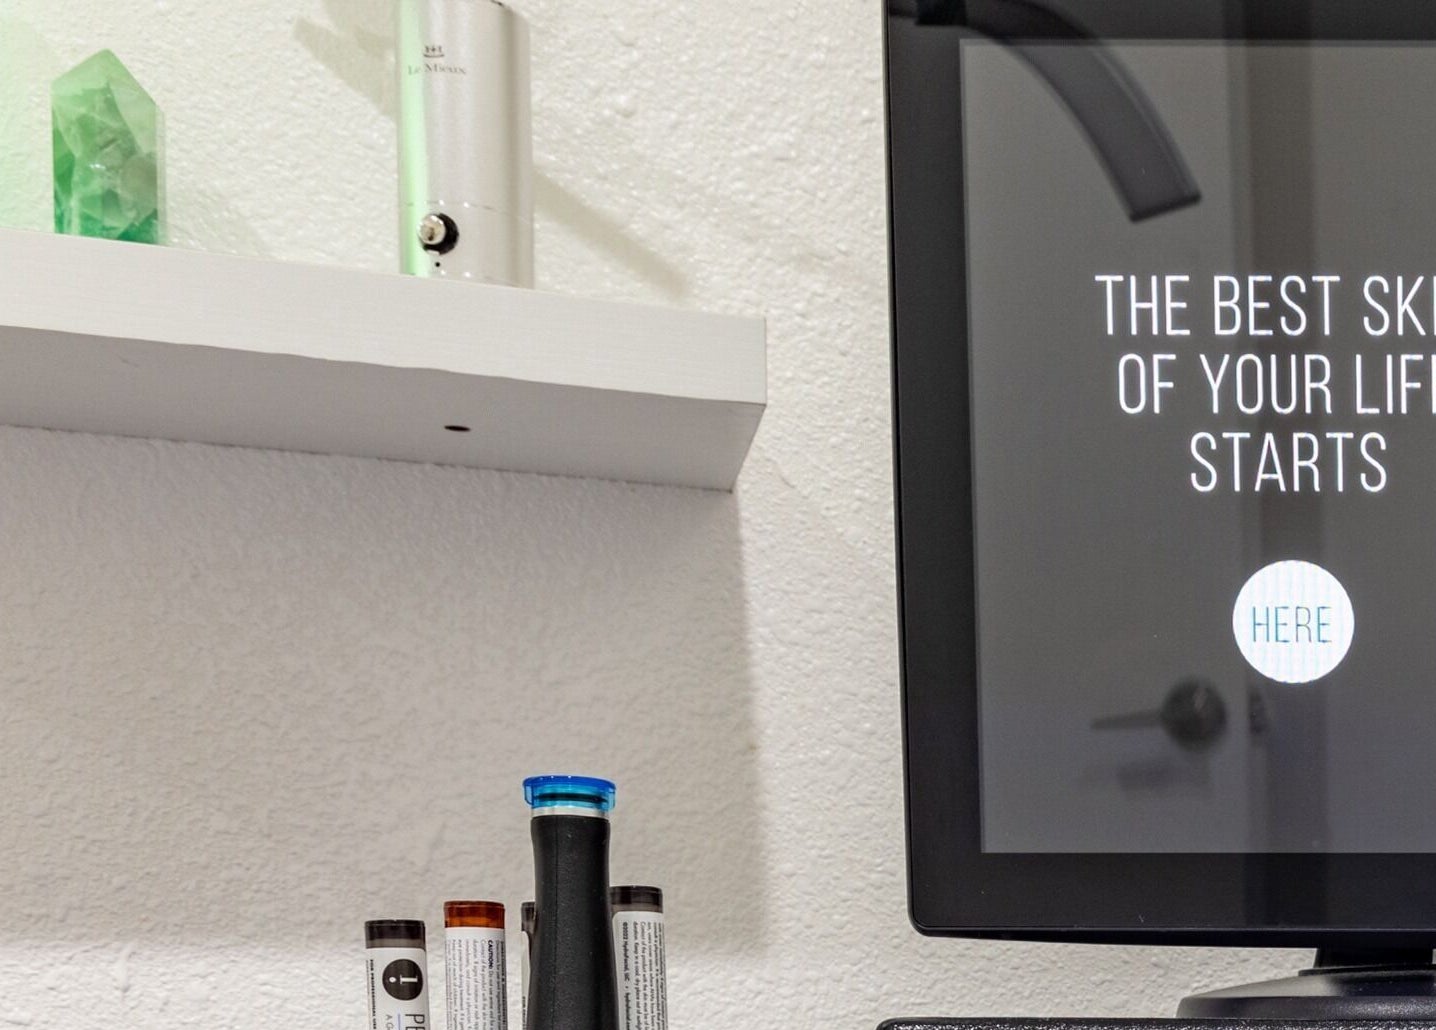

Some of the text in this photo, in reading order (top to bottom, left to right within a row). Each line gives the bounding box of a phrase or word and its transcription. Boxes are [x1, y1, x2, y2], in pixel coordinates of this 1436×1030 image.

[1094, 274, 1191, 336] THE
[1213, 275, 1341, 336] BEST
[1118, 353, 1177, 415] OF
[1199, 353, 1332, 415] YOUR
[1190, 431, 1387, 493] STARTS
[1252, 605, 1332, 643] HERE
